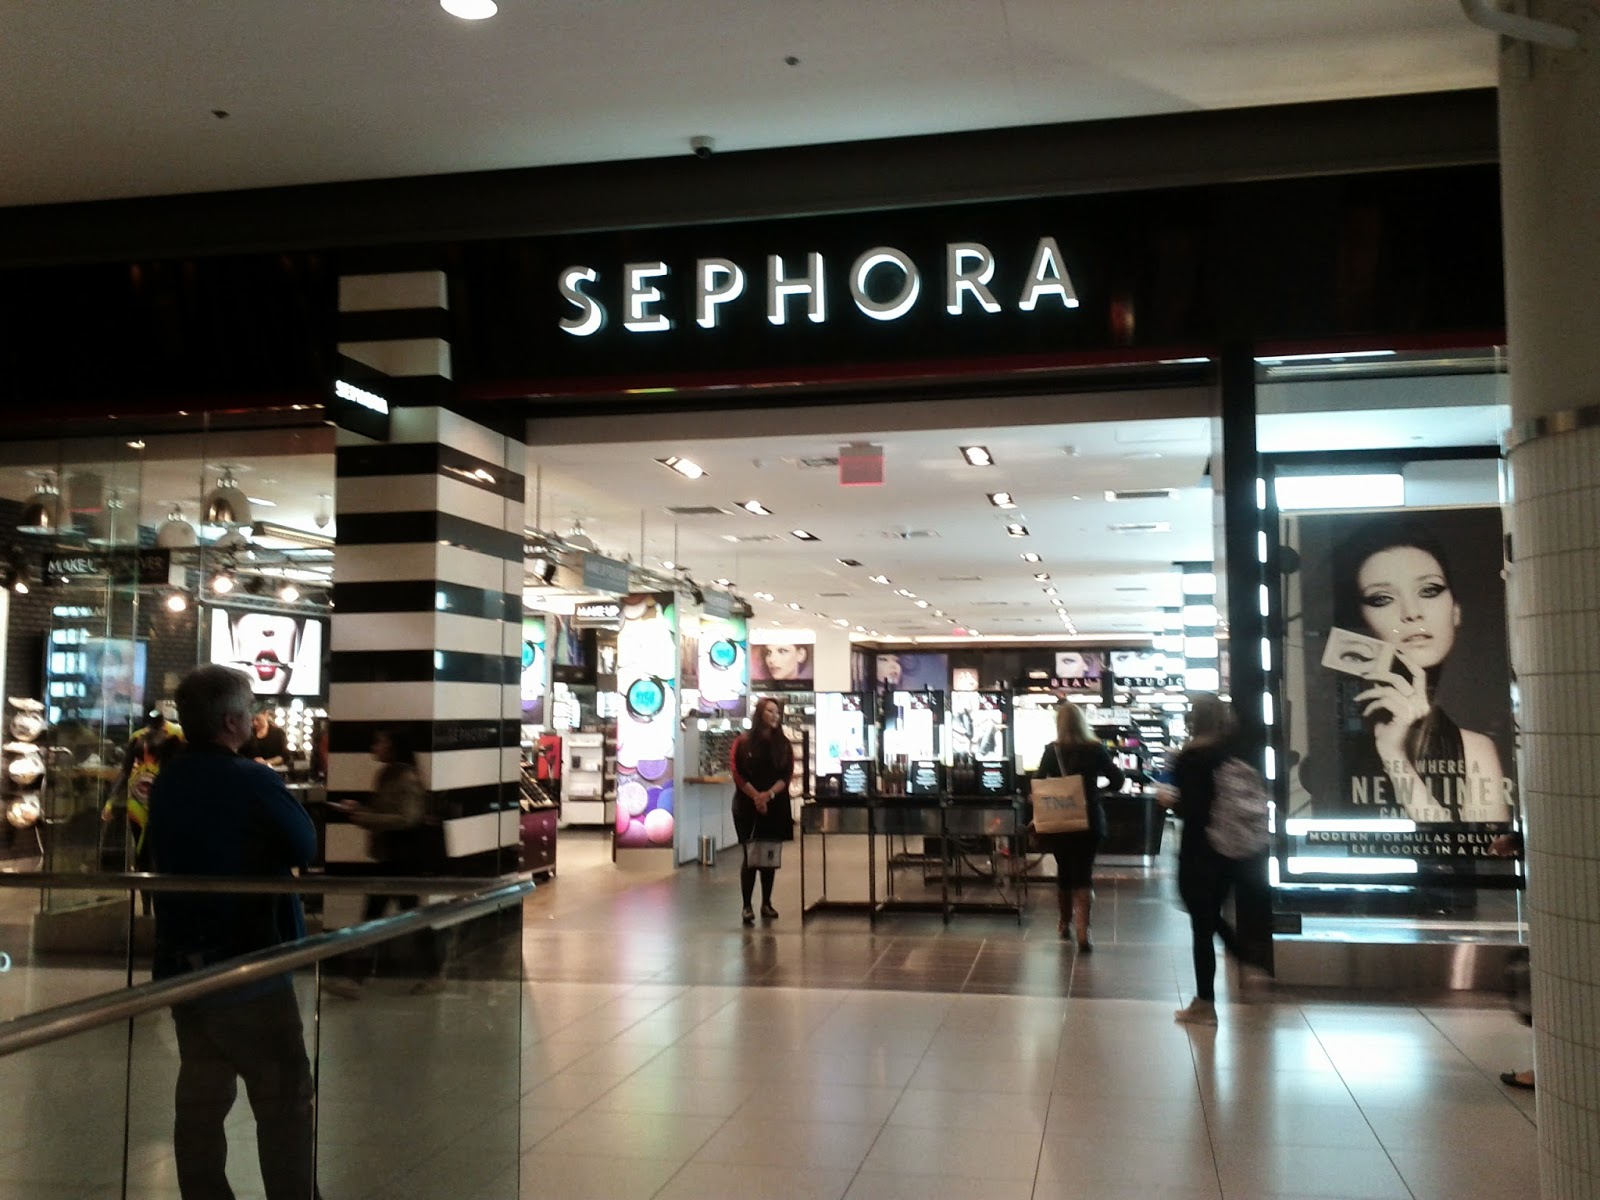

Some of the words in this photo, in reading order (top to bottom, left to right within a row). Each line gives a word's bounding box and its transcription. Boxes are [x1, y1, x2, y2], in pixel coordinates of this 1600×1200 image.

[558, 236, 1080, 337] SEPHORA
[1416, 760, 1465, 774] WHERE
[1472, 762, 1480, 773] A
[1352, 776, 1415, 805] NEW
[1424, 775, 1514, 806] LINER
[1309, 831, 1368, 841] MODERN
[1374, 833, 1450, 843] FORMULAS
[1352, 843, 1376, 854] EYE
[1382, 845, 1428, 854] LOOKS
[1435, 845, 1451, 855] IN
[1457, 846, 1467, 855] A
